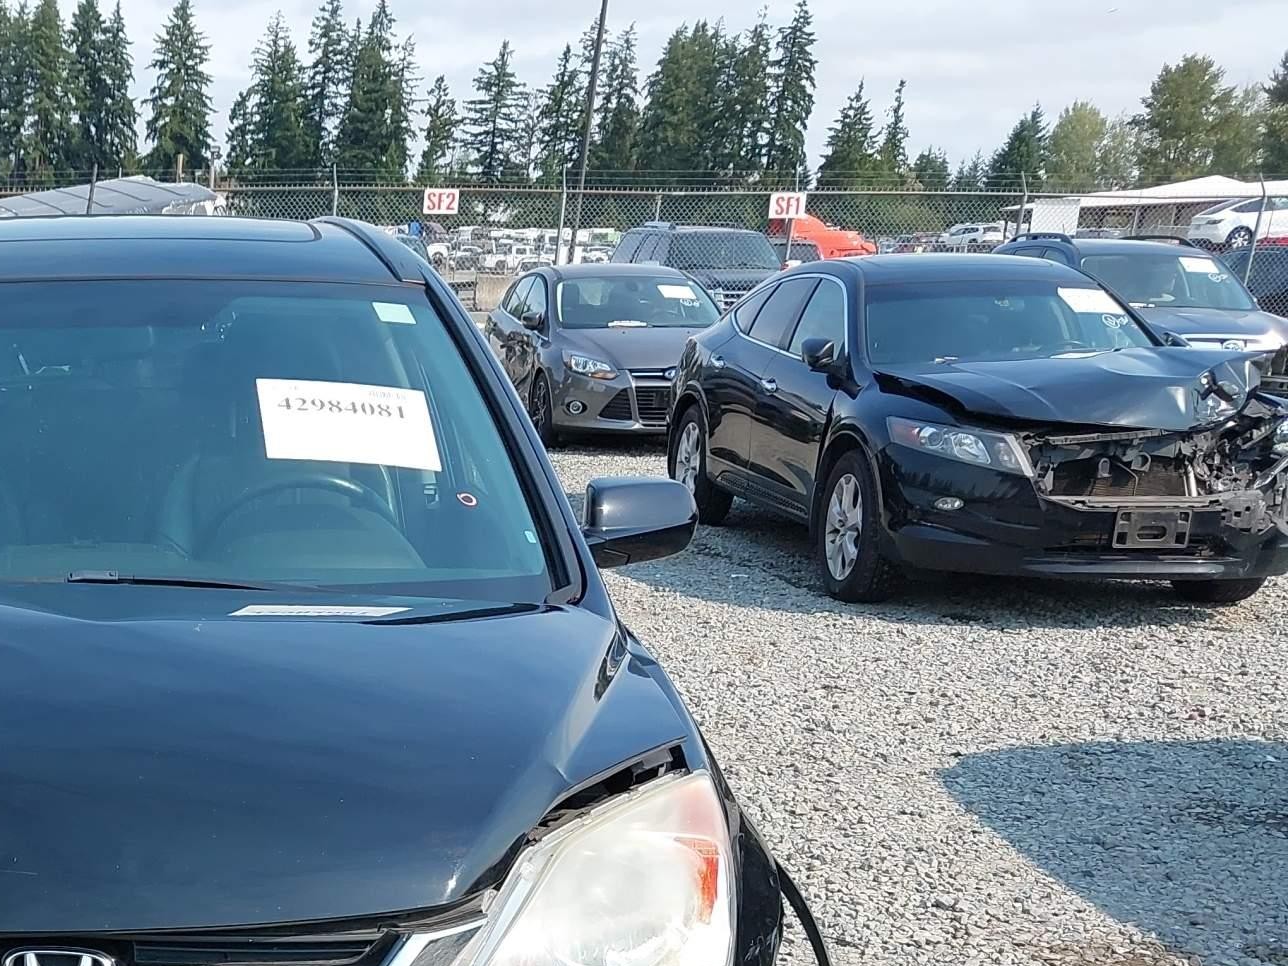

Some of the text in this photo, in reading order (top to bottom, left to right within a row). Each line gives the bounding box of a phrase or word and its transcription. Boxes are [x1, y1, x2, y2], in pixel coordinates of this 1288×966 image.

[427, 192, 456, 211] SF2
[775, 196, 801, 216] SF1
[277, 397, 405, 419] 42984081
